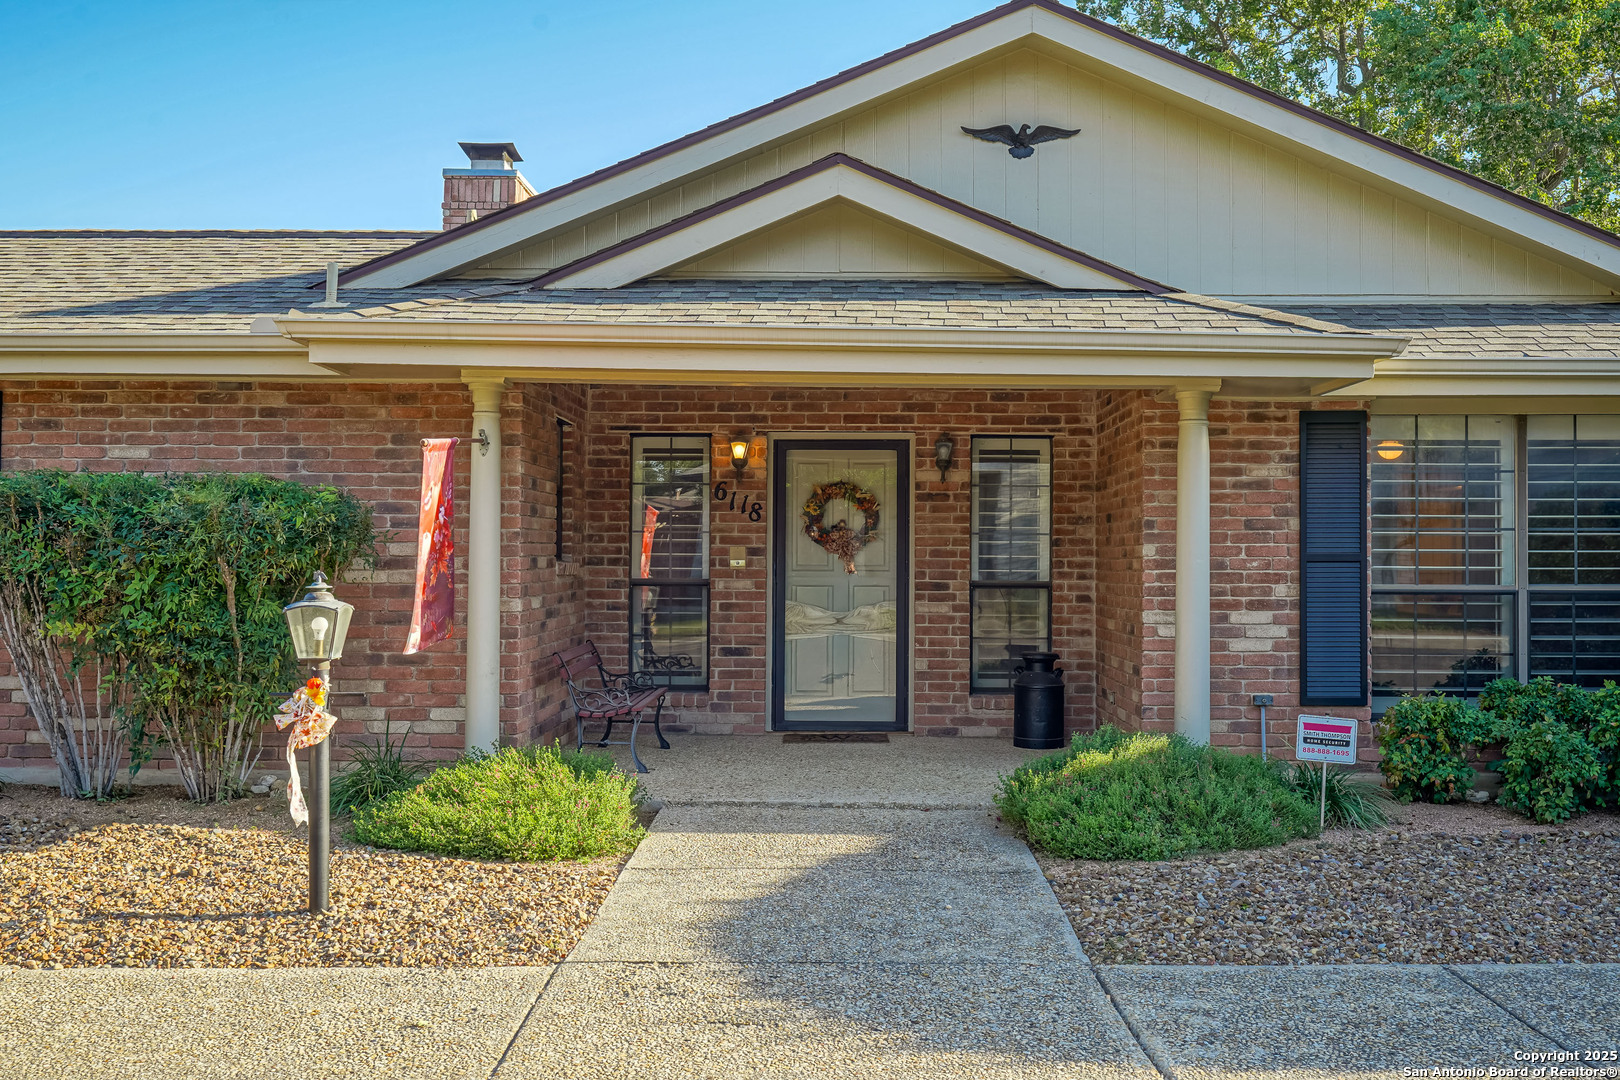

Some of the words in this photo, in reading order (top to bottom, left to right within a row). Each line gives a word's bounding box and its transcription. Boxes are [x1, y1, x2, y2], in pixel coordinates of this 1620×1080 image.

[714, 481, 763, 522] 6118
[1321, 732, 1352, 740] THOMPSON
[1302, 747, 1350, 757] 888-888-1695
